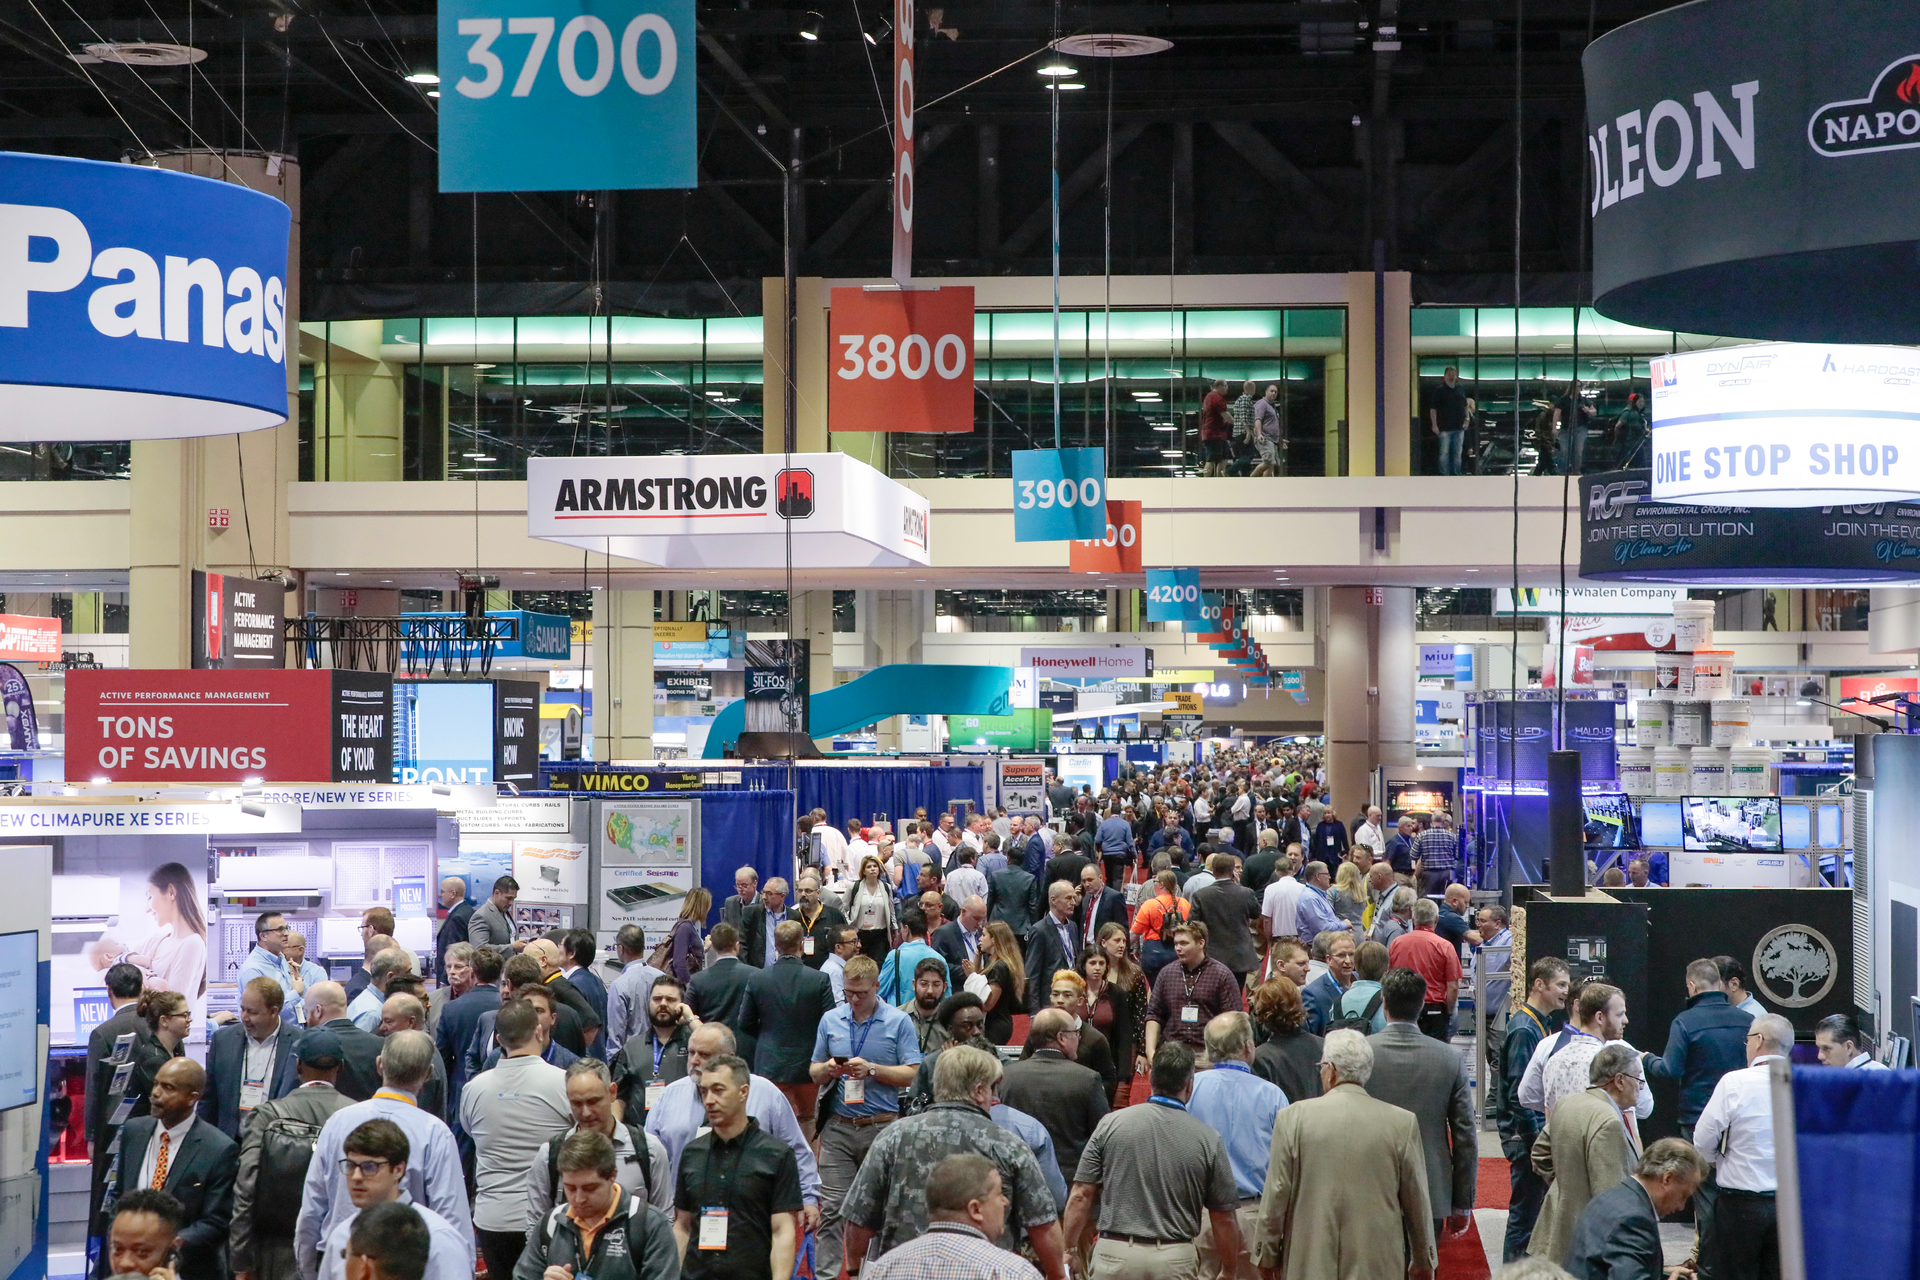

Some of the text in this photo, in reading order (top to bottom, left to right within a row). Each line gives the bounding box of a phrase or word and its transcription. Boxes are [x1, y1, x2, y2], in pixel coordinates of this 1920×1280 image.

[455, 13, 679, 99] 3700
[0, 203, 286, 364] Panas
[837, 333, 967, 381] 3800
[1657, 443, 1899, 484] ONE STOP SHOP
[555, 476, 767, 511] ARMSTRONG
[1018, 477, 1101, 510] 3900
[1587, 480, 1645, 521] RGF
[1636, 507, 1699, 516] ENVIRONMENTAL
[1701, 505, 1732, 514] GROUP,
[1896, 508, 1920, 518] ENVIRON
[1588, 522, 1754, 543] JOIN THE EVOLUTION
[1824, 522, 1867, 536] JOIN
[1869, 524, 1899, 538] THE
[1630, 540, 1662, 559] Clean
[1663, 538, 1692, 557] Air
[1893, 541, 1916, 558] Clean
[234, 592, 256, 608] ACTIVE
[1149, 584, 1198, 603] 4200
[1573, 588, 1618, 597] Whalen
[1621, 588, 1677, 599] Company
[233, 612, 275, 629] PERFORMANCE
[1200, 606, 1221, 619] 00
[233, 632, 274, 649] MANAGEMENT
[536, 624, 568, 653] SANHUA
[1032, 656, 1134, 670] Honeywell Home
[667, 678, 709, 686] EXHIBITS
[1210, 684, 1230, 697] LG
[100, 691, 270, 699] ACTIVE PERFORMANCE MANAGEMENT
[98, 716, 174, 739] TONS
[341, 714, 384, 738] THE HEART
[504, 717, 524, 738] KNOWS
[966, 718, 979, 727] GO
[979, 721, 1013, 733] green
[98, 747, 267, 770] OF SAVINGS
[341, 747, 374, 771] OF YOUR
[503, 744, 518, 765] HOW
[1005, 766, 1039, 775] Superior
[1005, 775, 1041, 783] AccuTrak
[582, 774, 649, 791] VIMCO
[294, 791, 346, 803] RE/NEW
[350, 791, 365, 803] YE
[369, 791, 413, 803] SERIES
[30, 813, 125, 828] CLIMAPURE
[130, 812, 150, 827] XE
[155, 812, 210, 827] SERIES
[400, 887, 422, 903] NEW
[400, 903, 423, 911] PRODUCT
[80, 1003, 108, 1022] NEW
